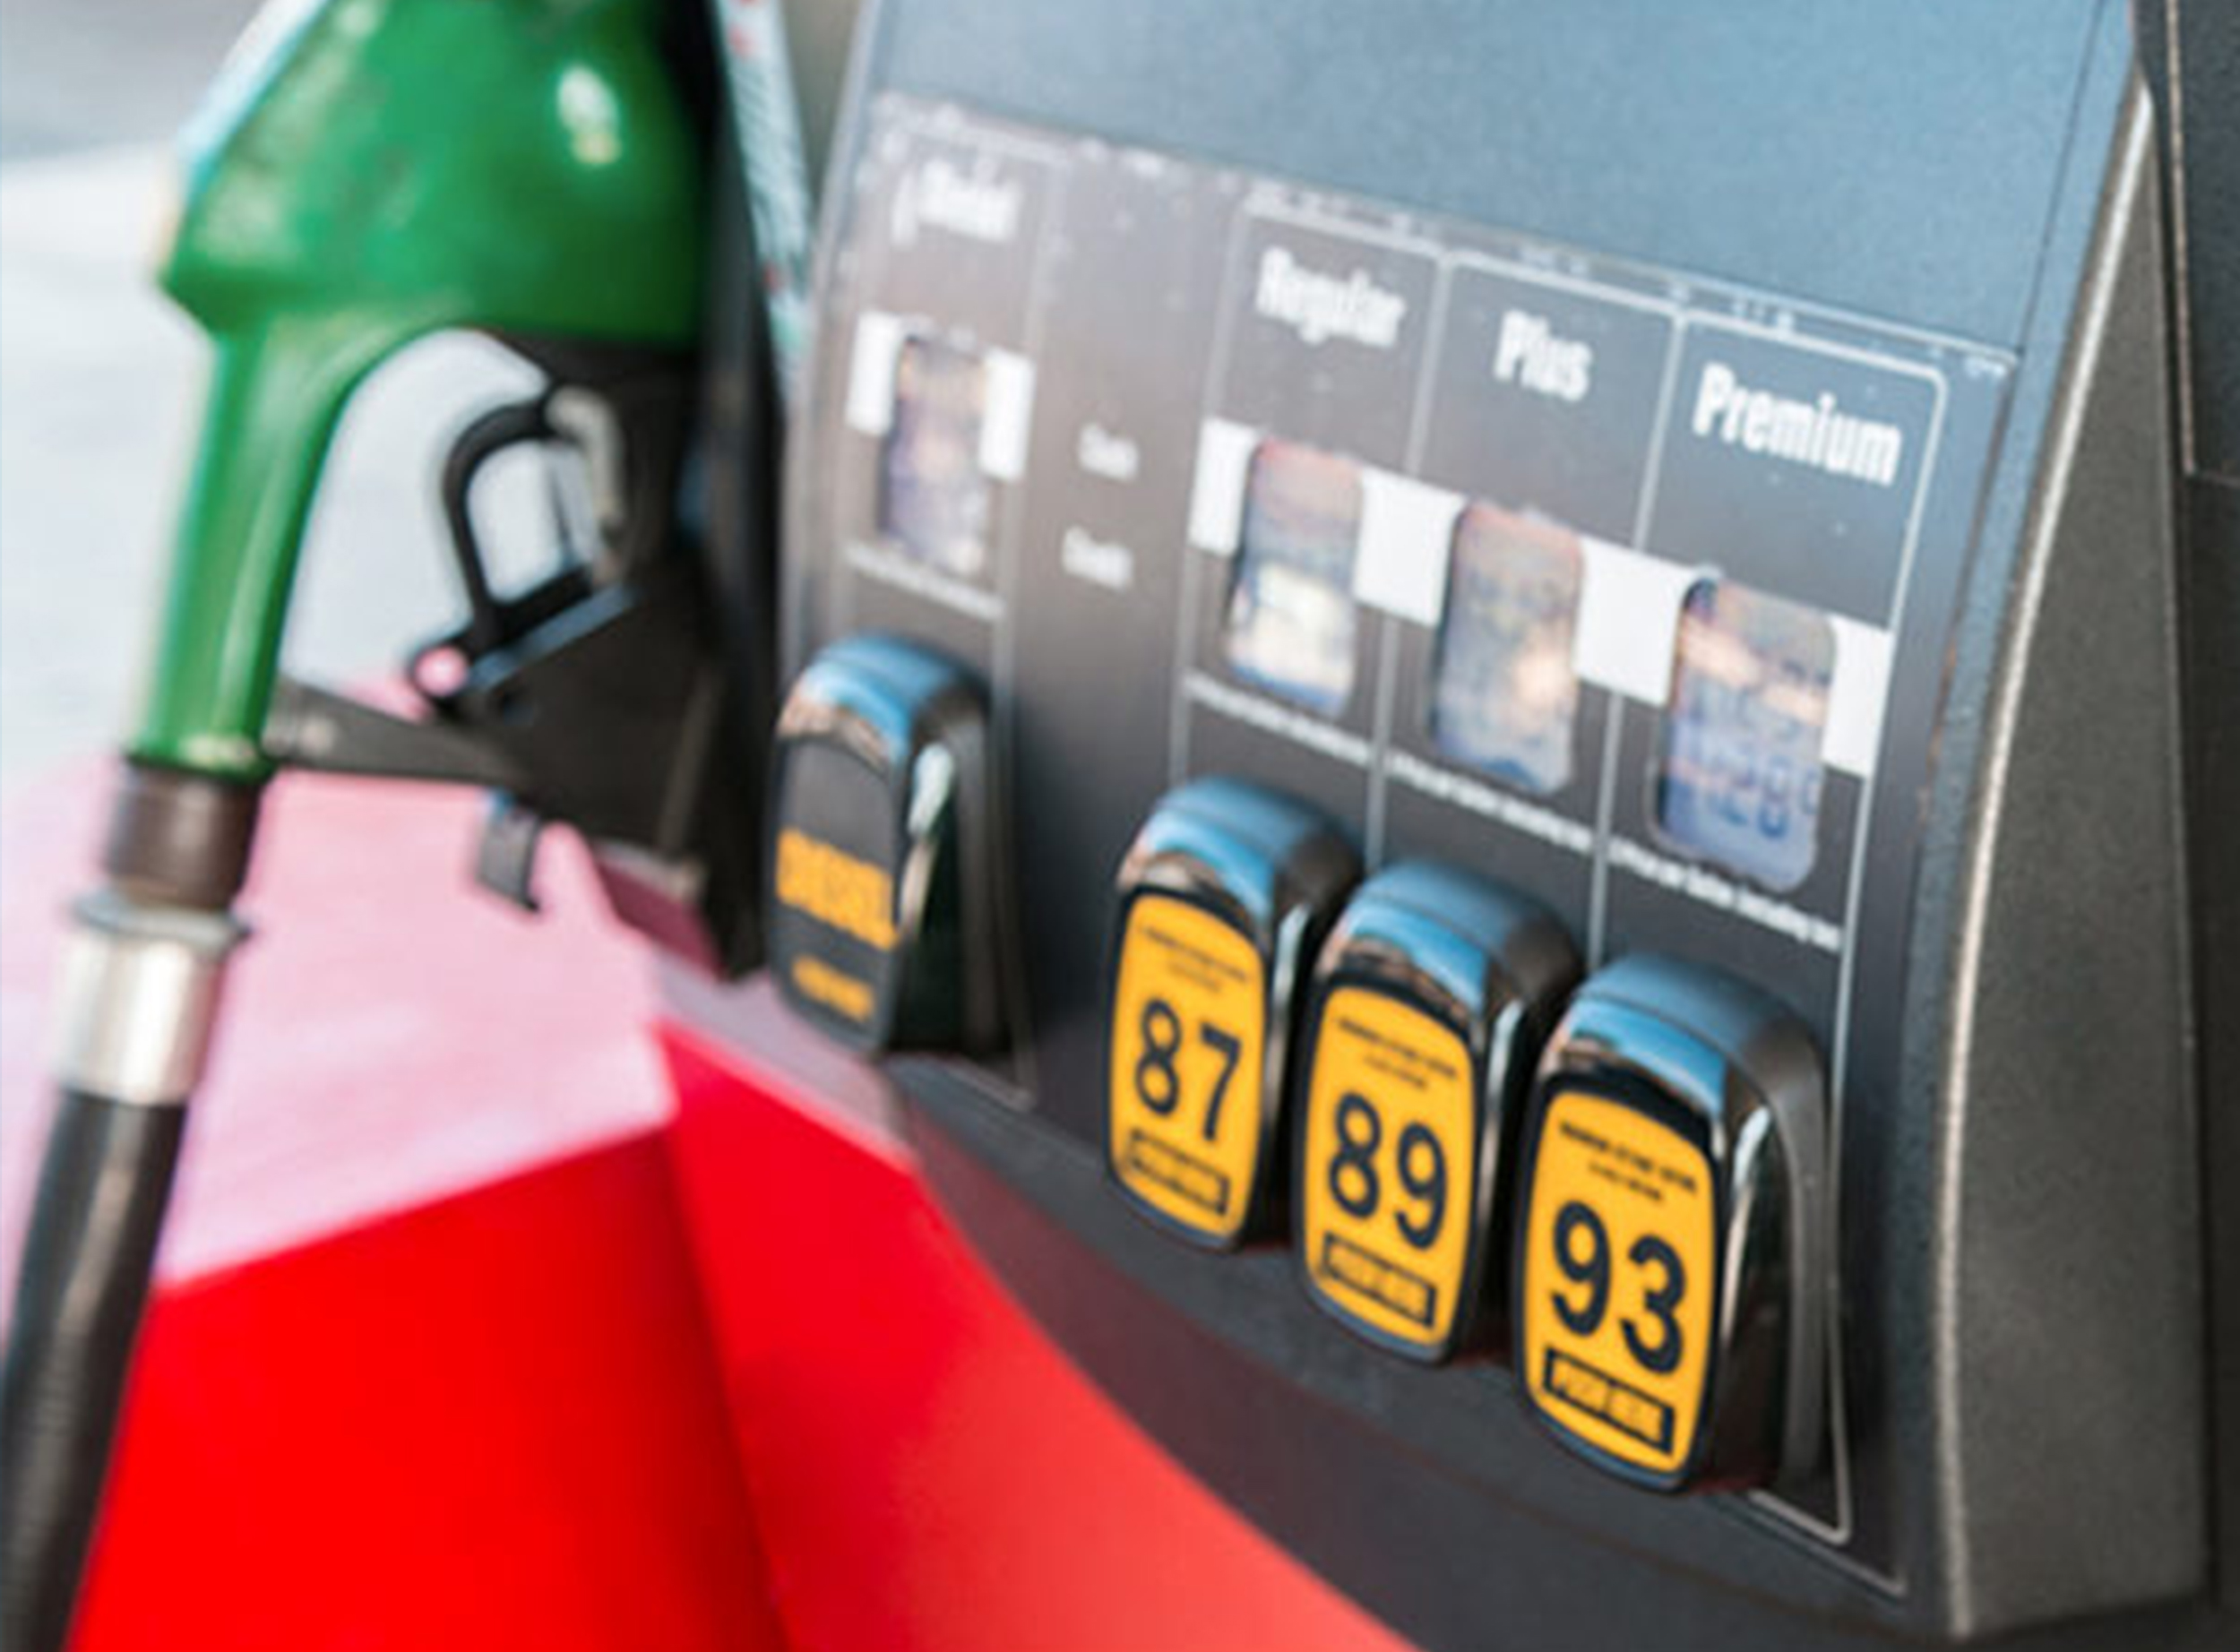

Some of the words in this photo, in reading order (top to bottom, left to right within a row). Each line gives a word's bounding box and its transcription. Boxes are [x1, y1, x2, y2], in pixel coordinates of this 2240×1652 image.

[1494, 309, 1593, 400] Plus
[1693, 362, 1902, 486] Premium
[1134, 998, 1243, 1142] 87
[1326, 1091, 1448, 1251] 89
[1550, 1200, 1686, 1375] 93
